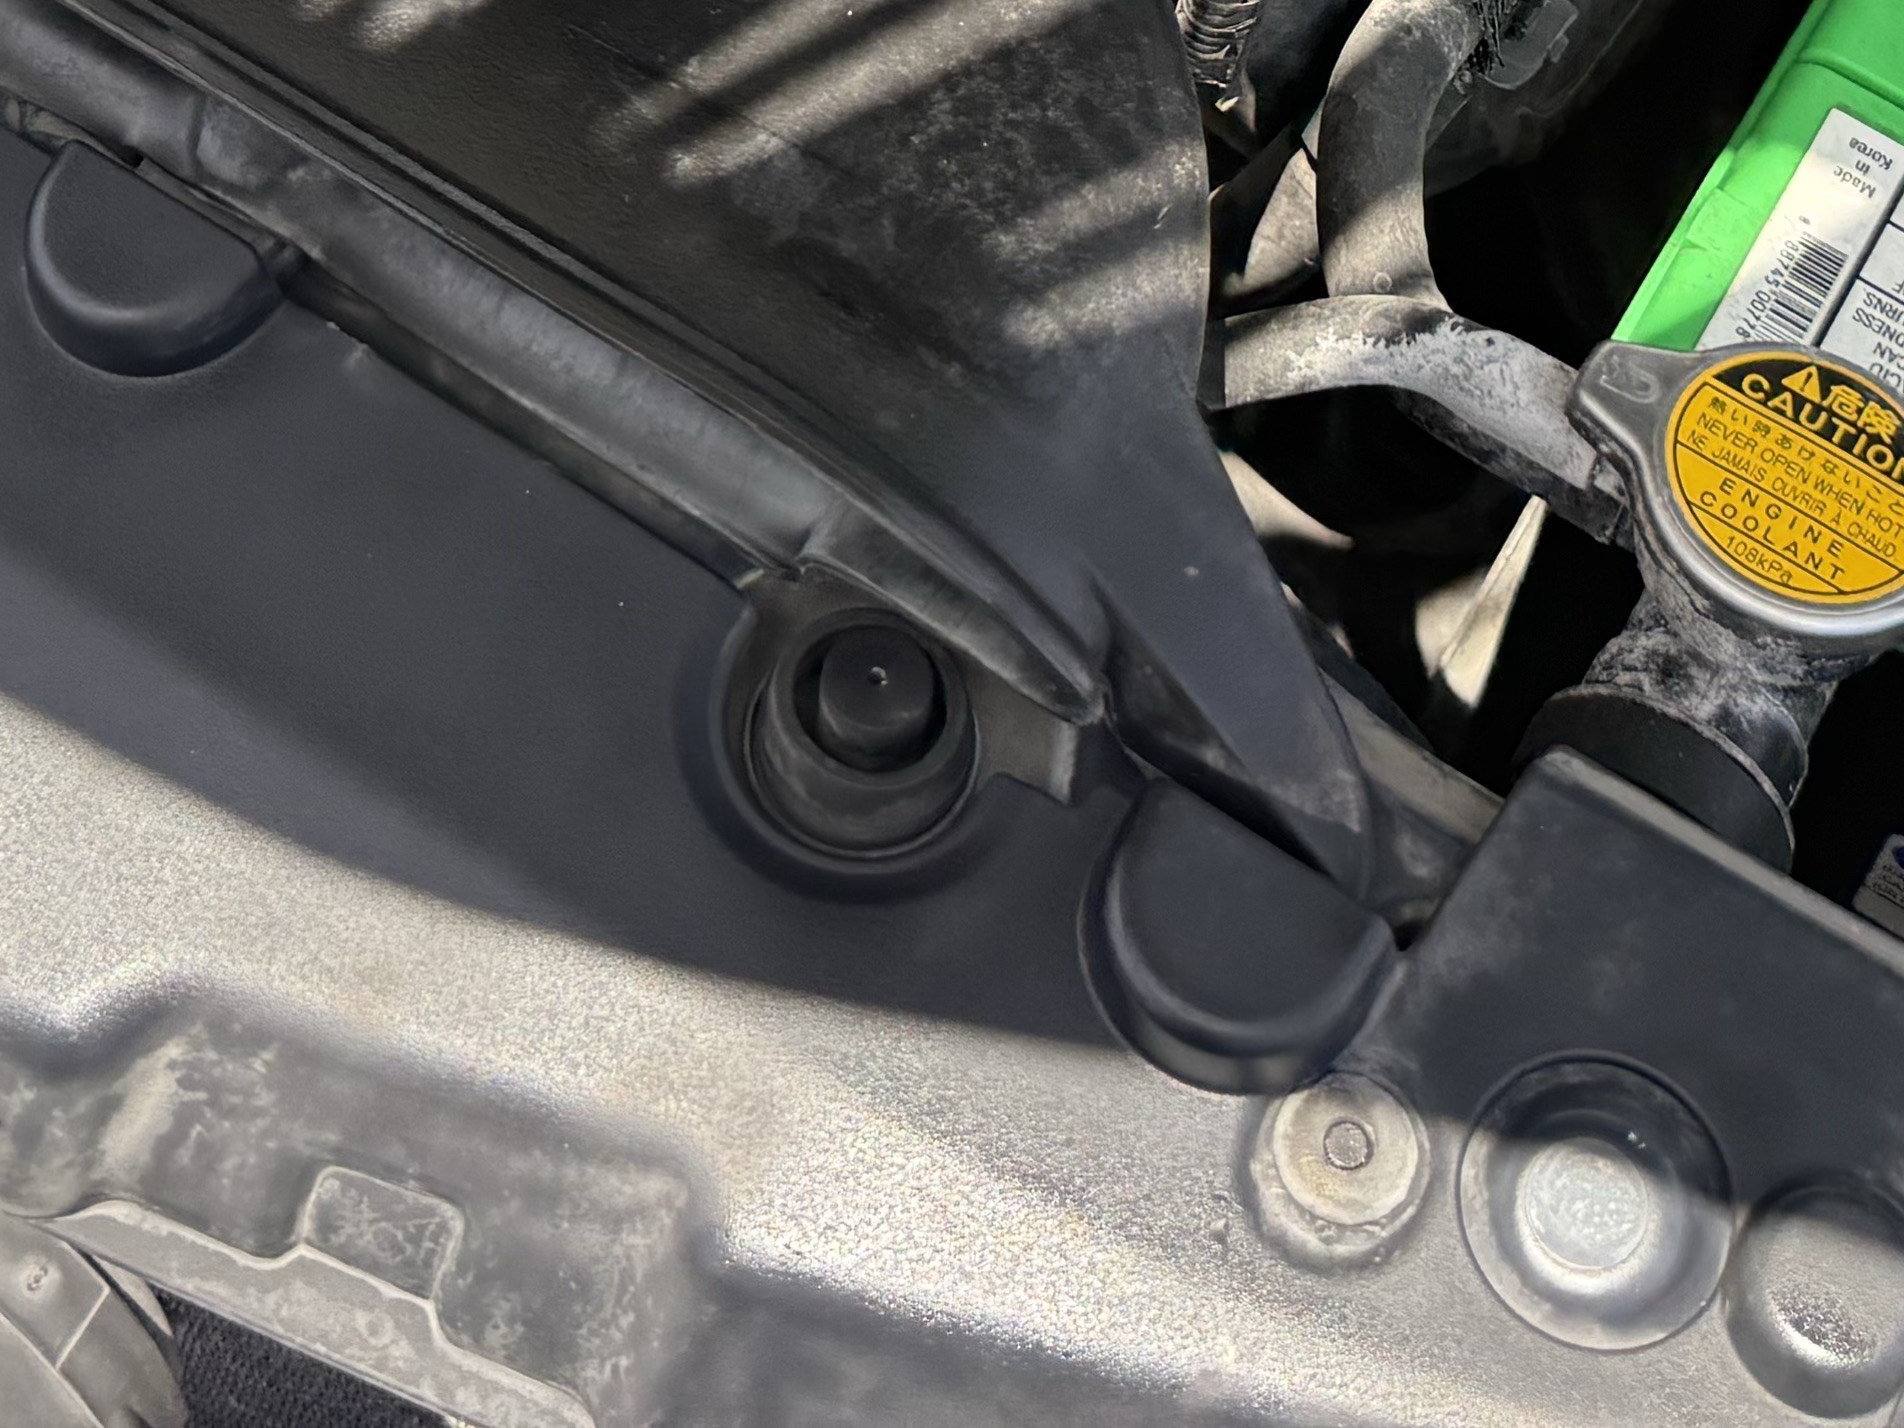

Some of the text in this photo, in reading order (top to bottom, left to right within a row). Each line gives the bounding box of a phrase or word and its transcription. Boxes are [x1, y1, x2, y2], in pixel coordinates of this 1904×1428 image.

[1834, 166, 1876, 198] Made
[1850, 138, 1892, 170] Korea
[1856, 160, 1870, 175] in
[1734, 288, 1772, 340] 00778
[1819, 379, 1904, 446] 危険
[1687, 430, 1709, 451] NE
[1712, 447, 1767, 482] JAMAIS
[1772, 477, 1827, 516] OUVRIR
[1830, 508, 1842, 526] À
[1696, 412, 1758, 454] NEVER
[1760, 448, 1812, 484] OPEN
[1814, 476, 1865, 515] WHEN
[1700, 491, 1845, 579] COOLANT
[1719, 478, 1844, 558] ENGINE
[1727, 536, 1792, 585] 108kPa
